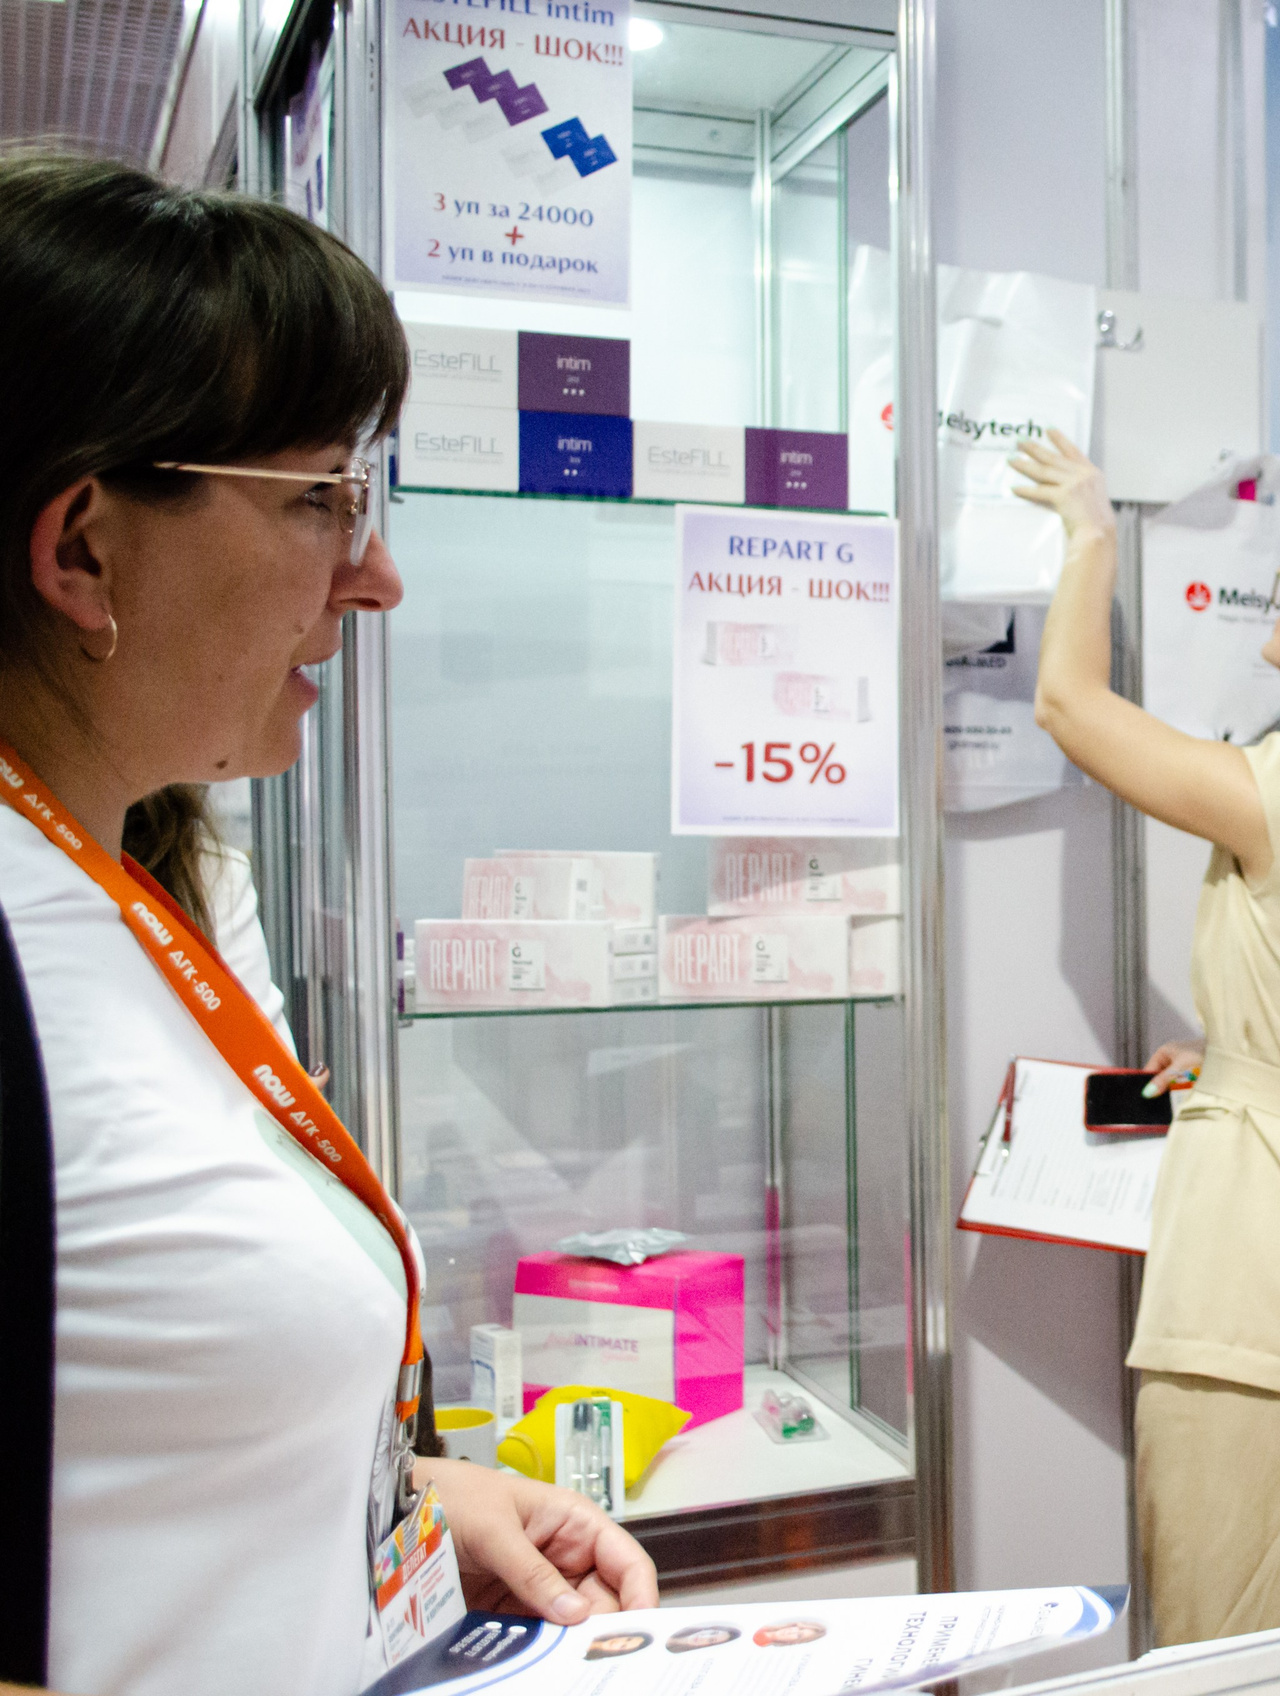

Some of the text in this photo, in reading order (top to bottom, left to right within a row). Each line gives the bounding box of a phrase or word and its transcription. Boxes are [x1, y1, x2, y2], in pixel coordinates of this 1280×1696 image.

[548, 1, 615, 27] intim
[402, 17, 505, 49] АКЦИЯ
[534, 34, 624, 66] ШОК!!!
[433, 192, 594, 227] 3 уп за 24000
[427, 239, 599, 274] 2 уп в подарок
[413, 348, 503, 373] EsteFILL
[556, 355, 592, 371] intim
[414, 431, 503, 455] EsteFILL
[557, 436, 592, 452] intim
[780, 449, 813, 466] intim
[728, 535, 854, 563] REPART G
[687, 571, 783, 599] АКЦИЯ
[808, 579, 891, 603] ШОК!!!
[0, 757, 24, 790] ow
[714, 742, 847, 786] -15%
[725, 852, 794, 902] REPART
[132, 901, 175, 947] now
[429, 938, 498, 990] REPART
[673, 933, 741, 984] REPART
[253, 1063, 297, 1109] now
[574, 1333, 639, 1354] INTIMATE
[402, 1541, 428, 1584] ДЕЛЕГАТ
[922, 1615, 959, 1668] ПРИМЕНЕ
